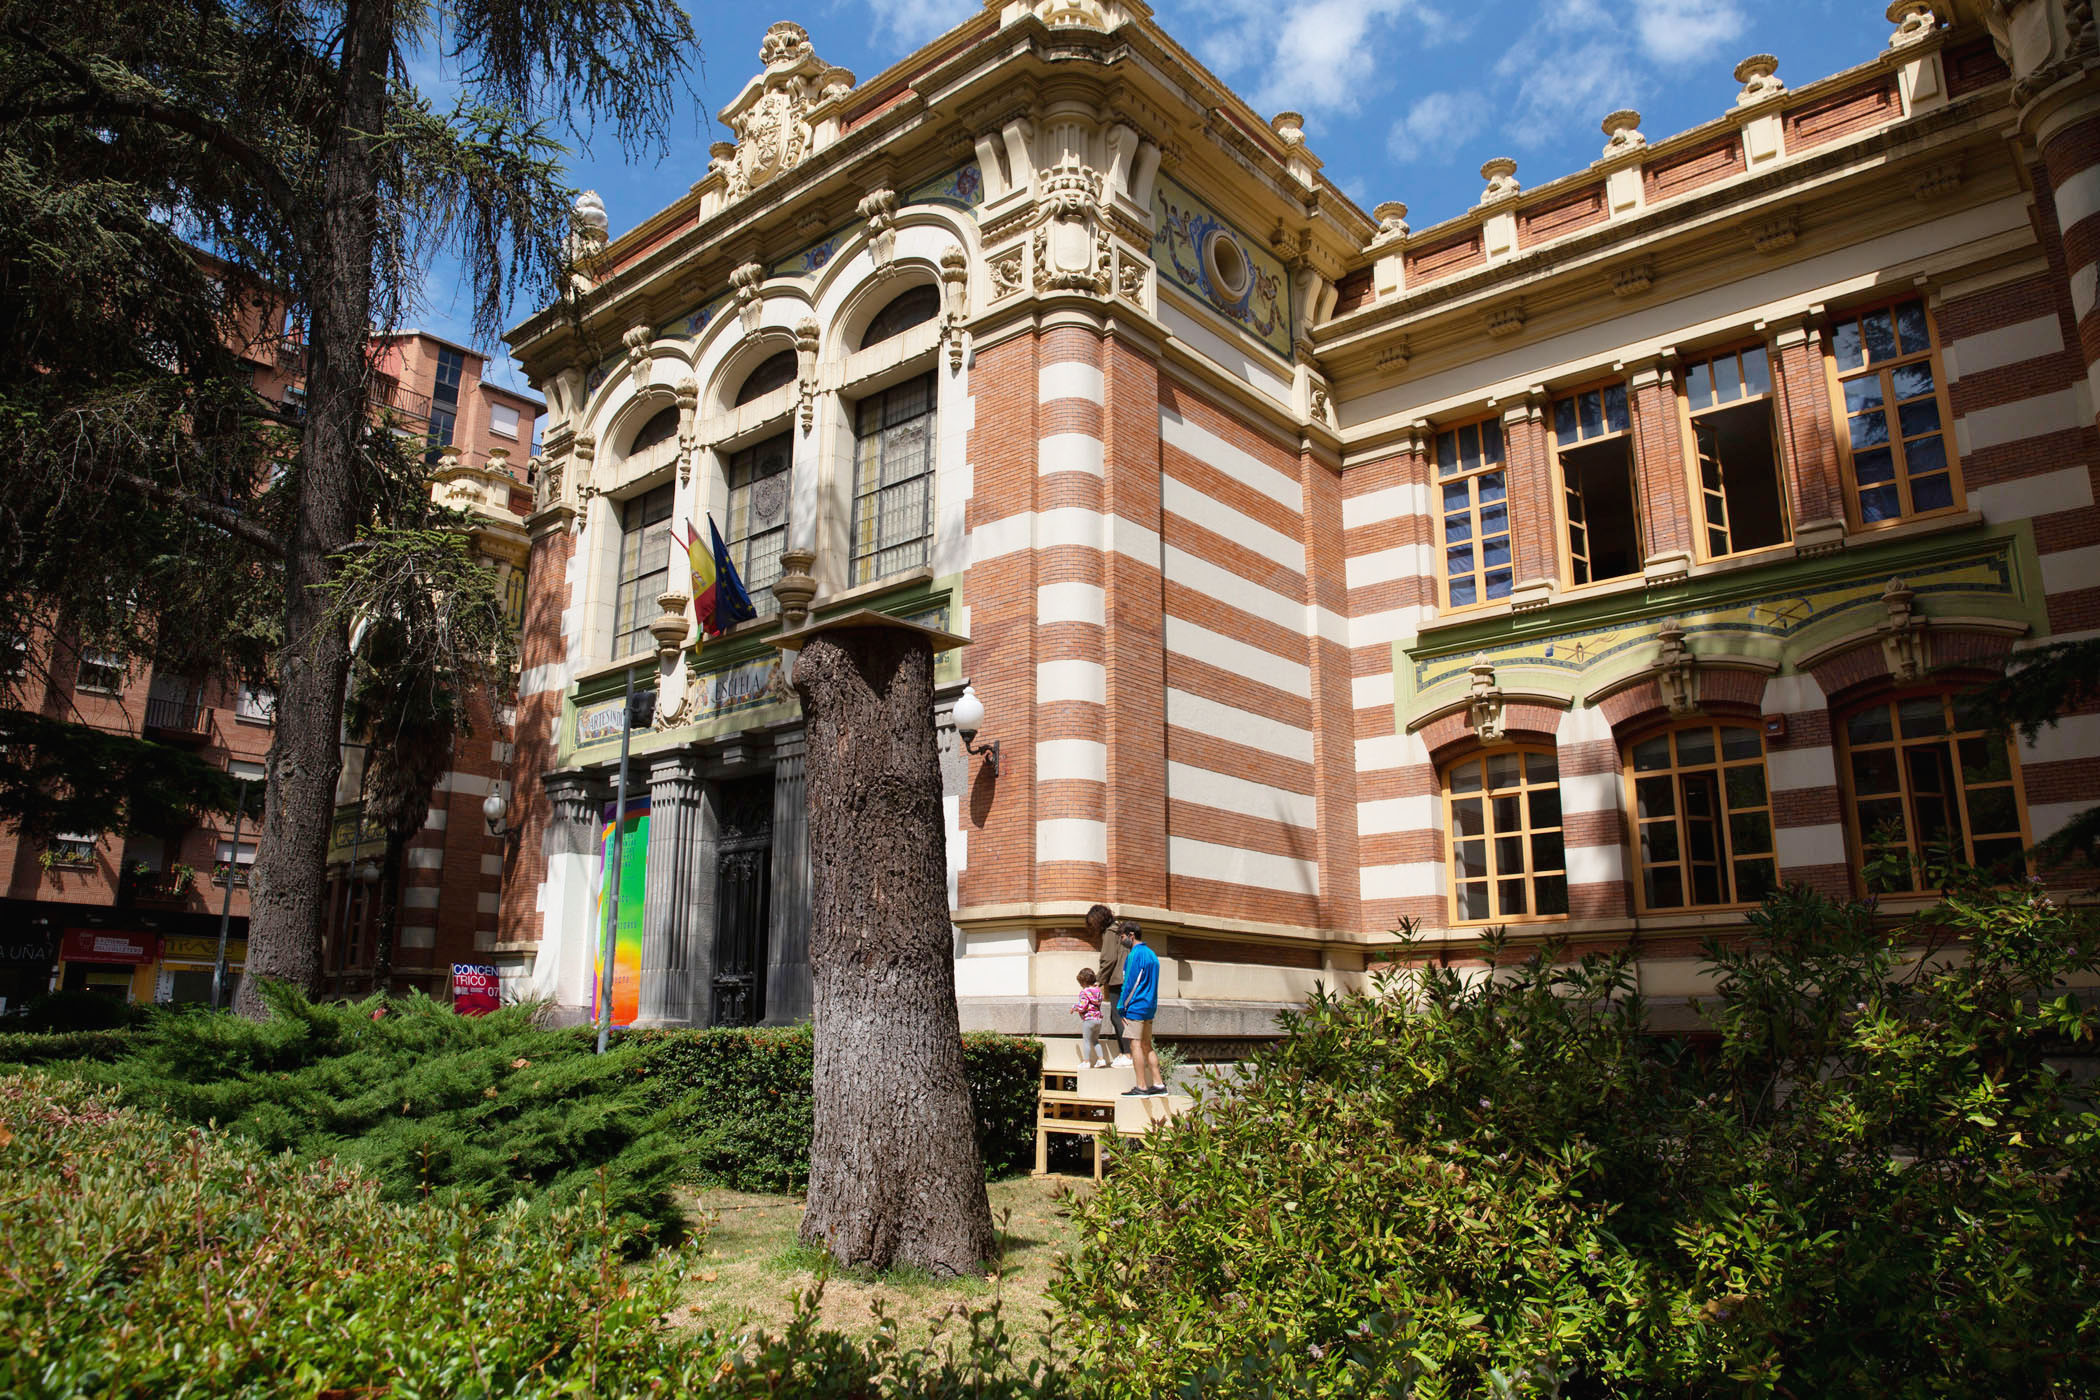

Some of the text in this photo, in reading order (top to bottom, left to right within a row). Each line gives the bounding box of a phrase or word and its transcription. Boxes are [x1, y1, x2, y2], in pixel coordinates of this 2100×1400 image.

[715, 673, 760, 702] ESCUELA
[591, 709, 610, 730] ARTES
[455, 975, 486, 986] TRICO
[487, 986, 499, 997] 07
